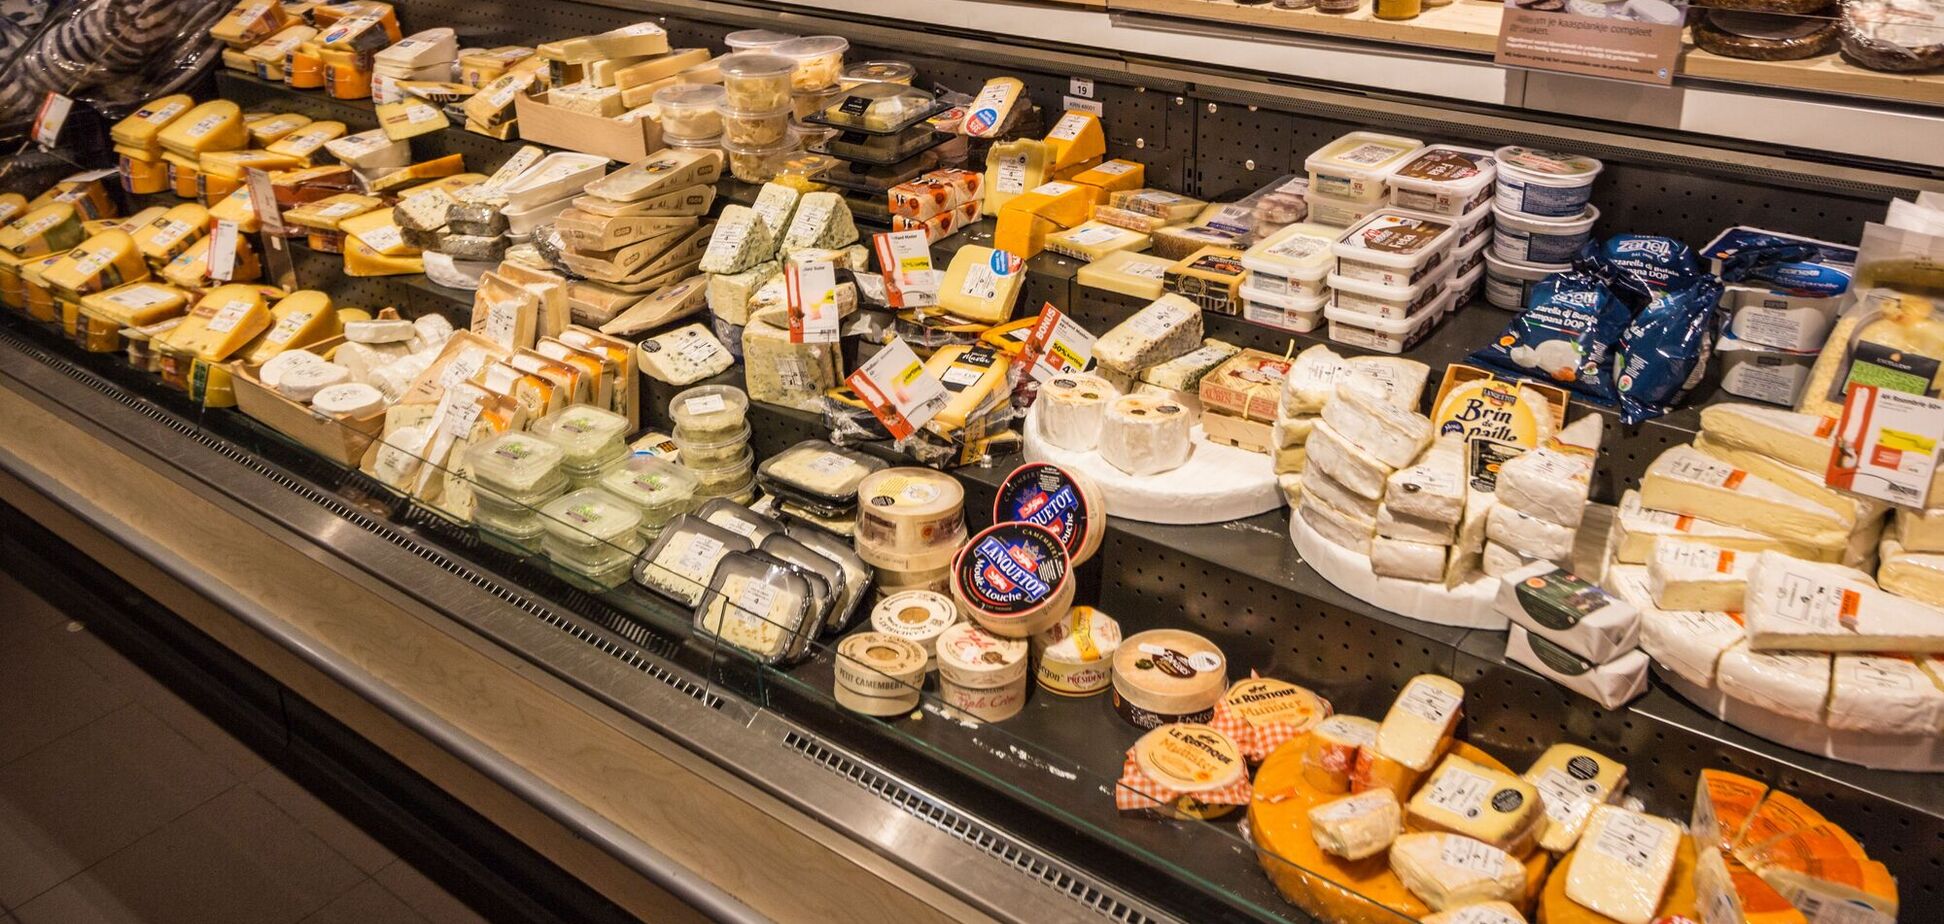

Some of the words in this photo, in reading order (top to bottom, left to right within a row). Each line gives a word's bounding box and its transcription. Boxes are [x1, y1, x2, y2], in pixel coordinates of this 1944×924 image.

[1610, 26, 1652, 37] compleet
[1078, 85, 1087, 95] 19
[1649, 270, 1669, 280] DOP
[1562, 309, 1570, 318] di
[1036, 308, 1056, 340] BONUS
[1563, 319, 1586, 329] DOP
[1053, 343, 1067, 357] 50%
[1066, 354, 1083, 367] korting
[1062, 365, 1071, 374] 4
[1455, 398, 1512, 424] Brin
[1482, 420, 1493, 428] de
[1027, 489, 1073, 526] QUETOT
[1061, 512, 1074, 544] ouche
[981, 540, 1046, 597] LANQUETOT
[986, 589, 1022, 602] Louche
[840, 667, 854, 682] PETIT
[855, 677, 904, 690] CAMEMBERT
[1229, 698, 1240, 706] LE
[1242, 687, 1297, 705] RUSTIQUE
[1169, 728, 1181, 738] LE
[1181, 735, 1234, 765] RUSTIQUE
